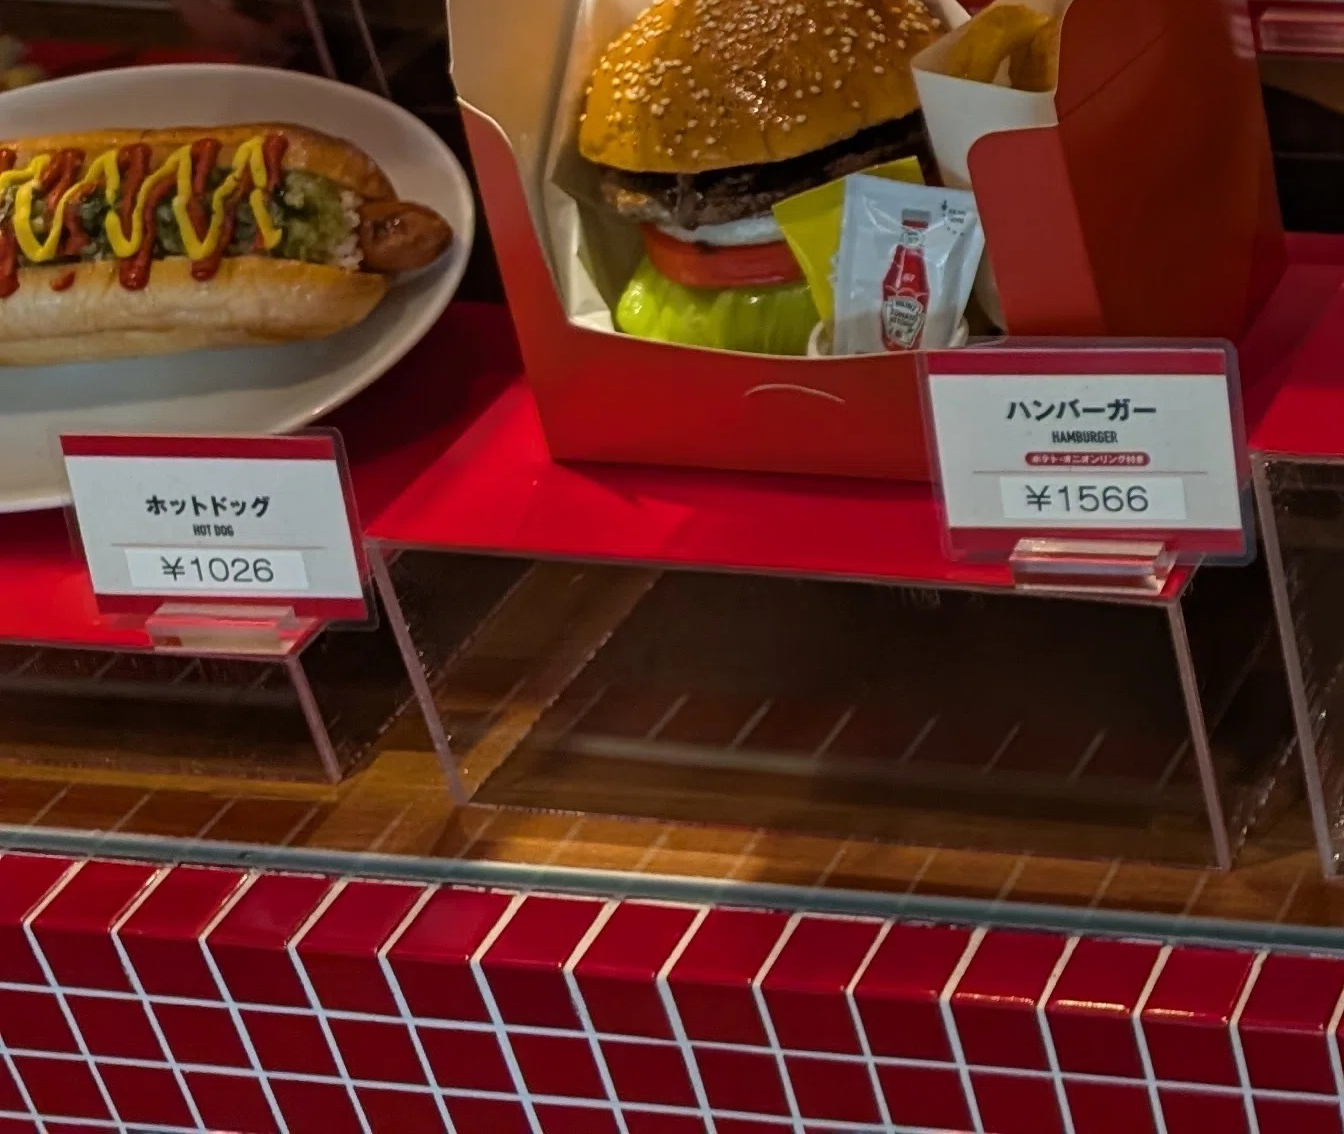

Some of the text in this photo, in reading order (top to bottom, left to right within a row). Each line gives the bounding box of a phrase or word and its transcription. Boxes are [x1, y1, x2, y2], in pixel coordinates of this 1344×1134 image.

[1007, 398, 1157, 422] ハンバーガー
[1051, 430, 1119, 444] HAMBURGER
[145, 494, 271, 518] ホットドッグ
[1025, 484, 1150, 513] ¥1566
[193, 524, 235, 537] HOT DOG
[159, 555, 275, 583] ¥1026
